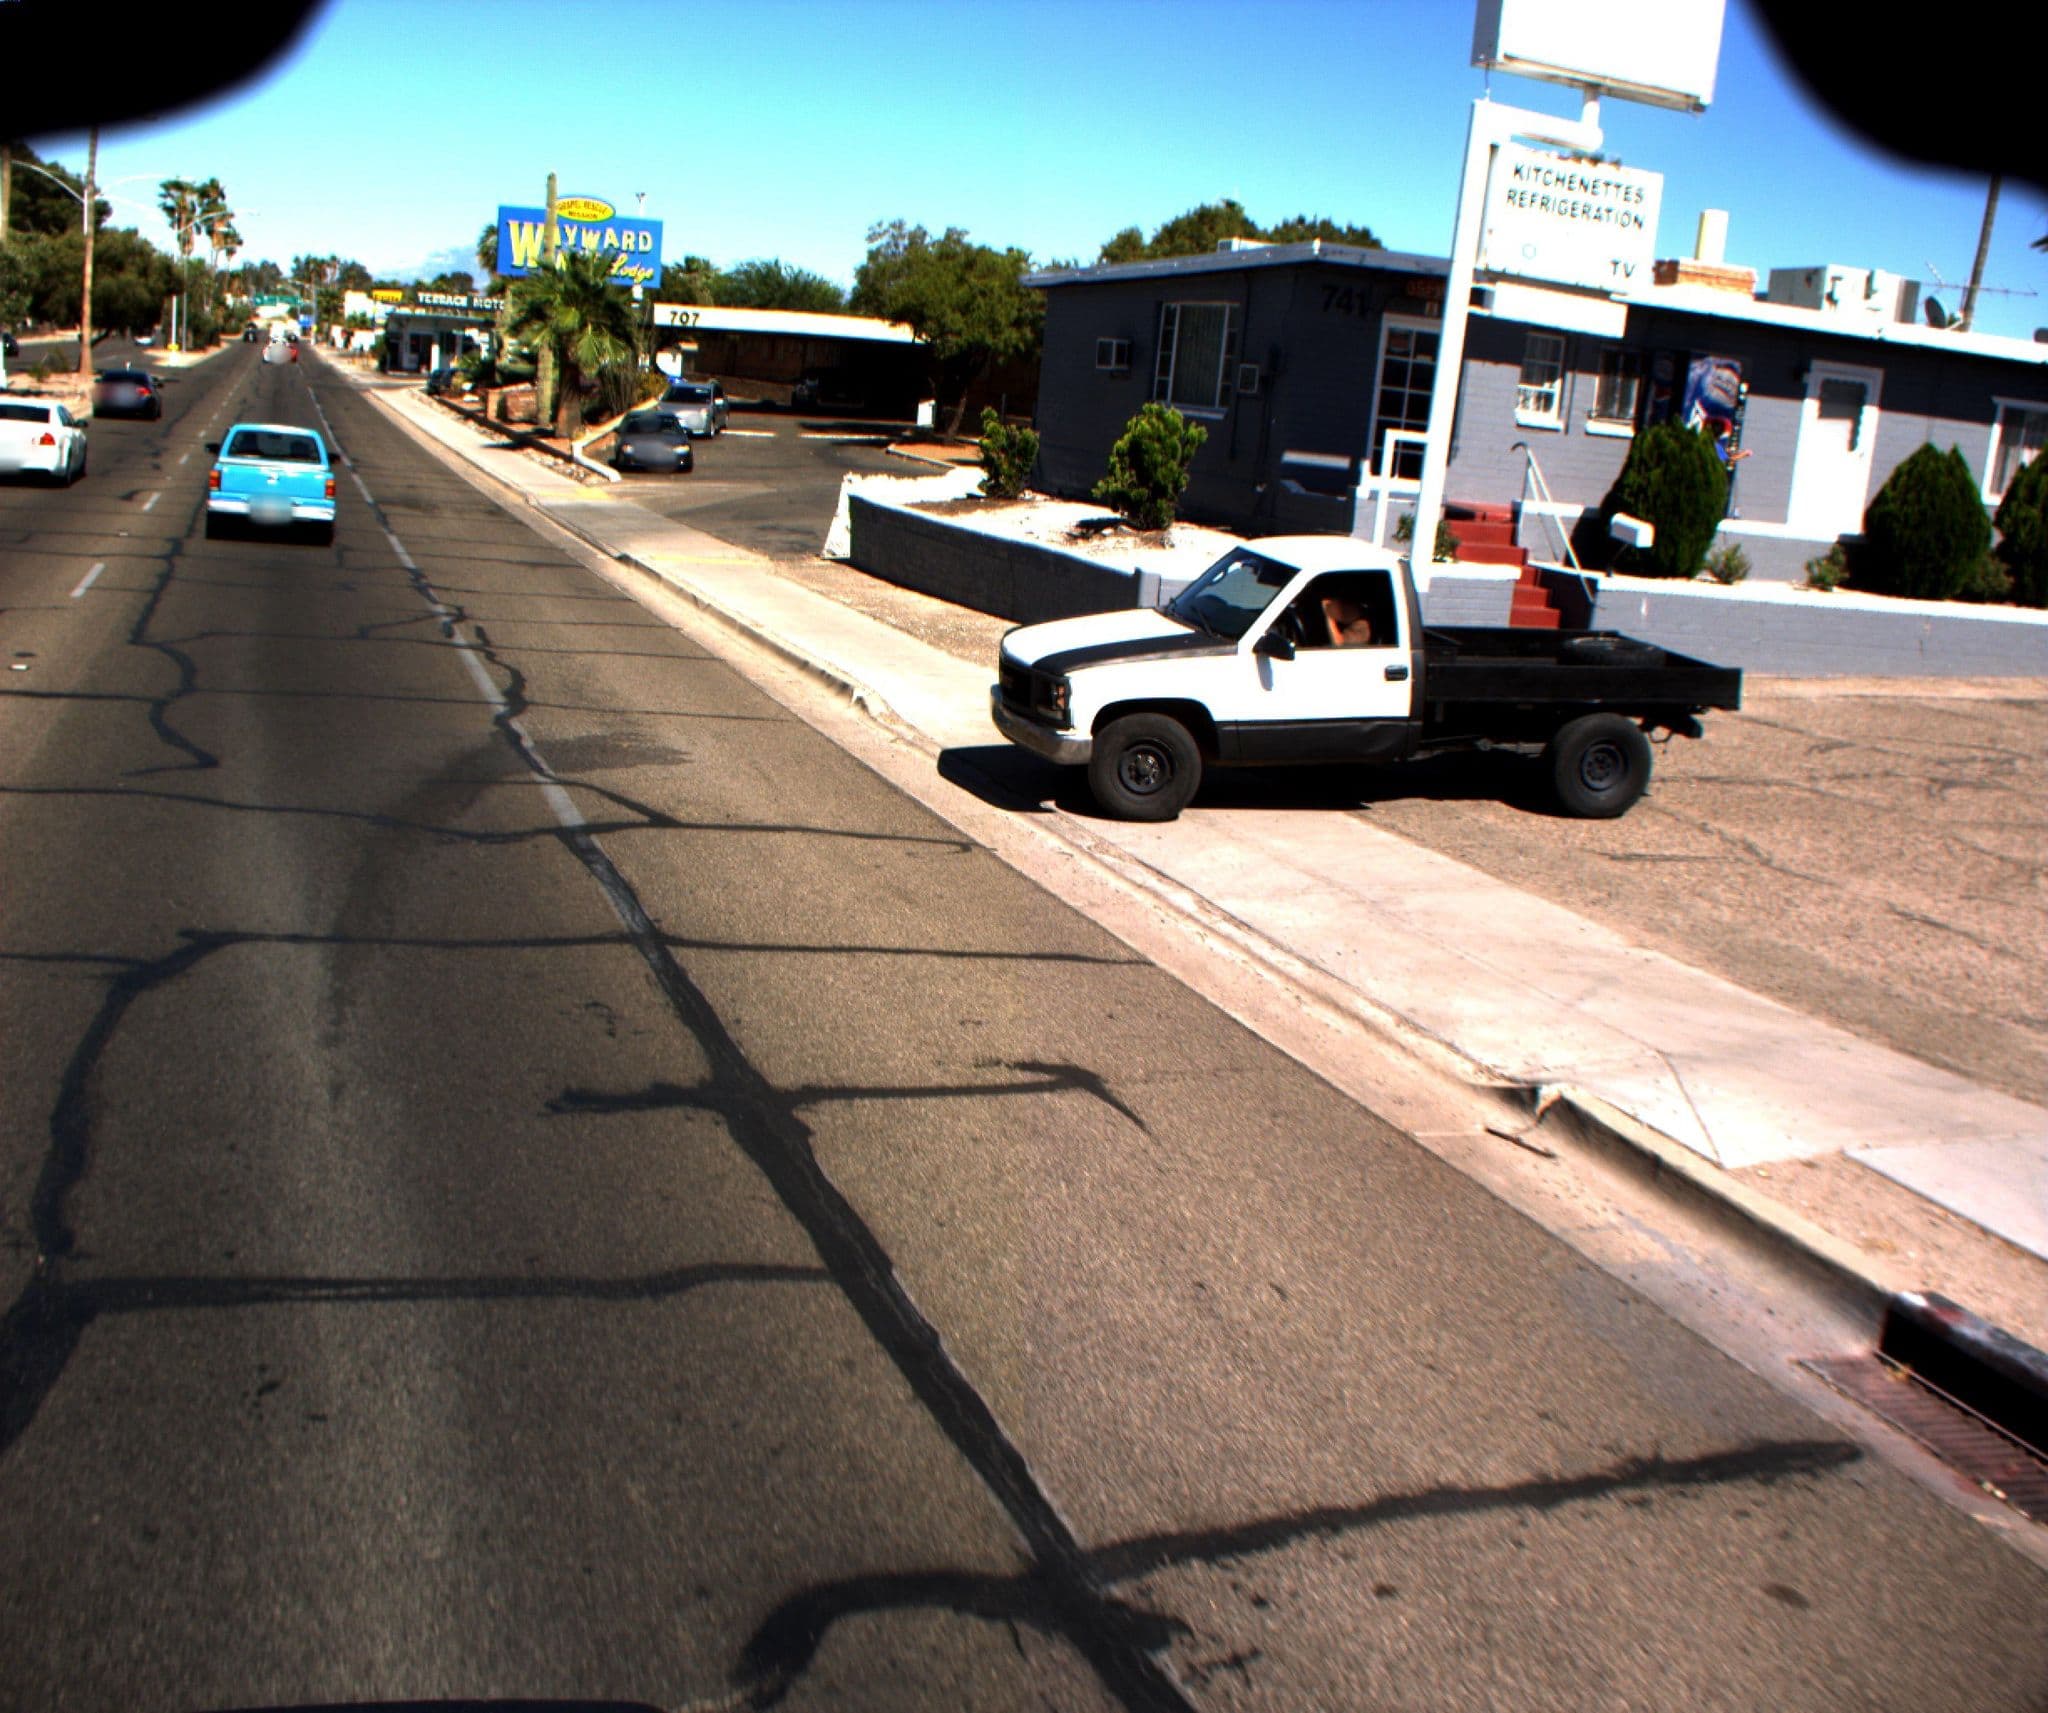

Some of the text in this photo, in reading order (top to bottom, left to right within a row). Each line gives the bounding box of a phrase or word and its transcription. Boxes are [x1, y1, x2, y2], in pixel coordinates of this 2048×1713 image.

[1513, 162, 1645, 205] KITCHENETTES
[1506, 188, 1645, 231] REFRIGERATION
[610, 252, 655, 283] Lodge
[1609, 258, 1637, 279] TV
[418, 291, 505, 310] TERRACE MOTE
[1320, 283, 1367, 315] 741
[670, 310, 700, 327] 707
